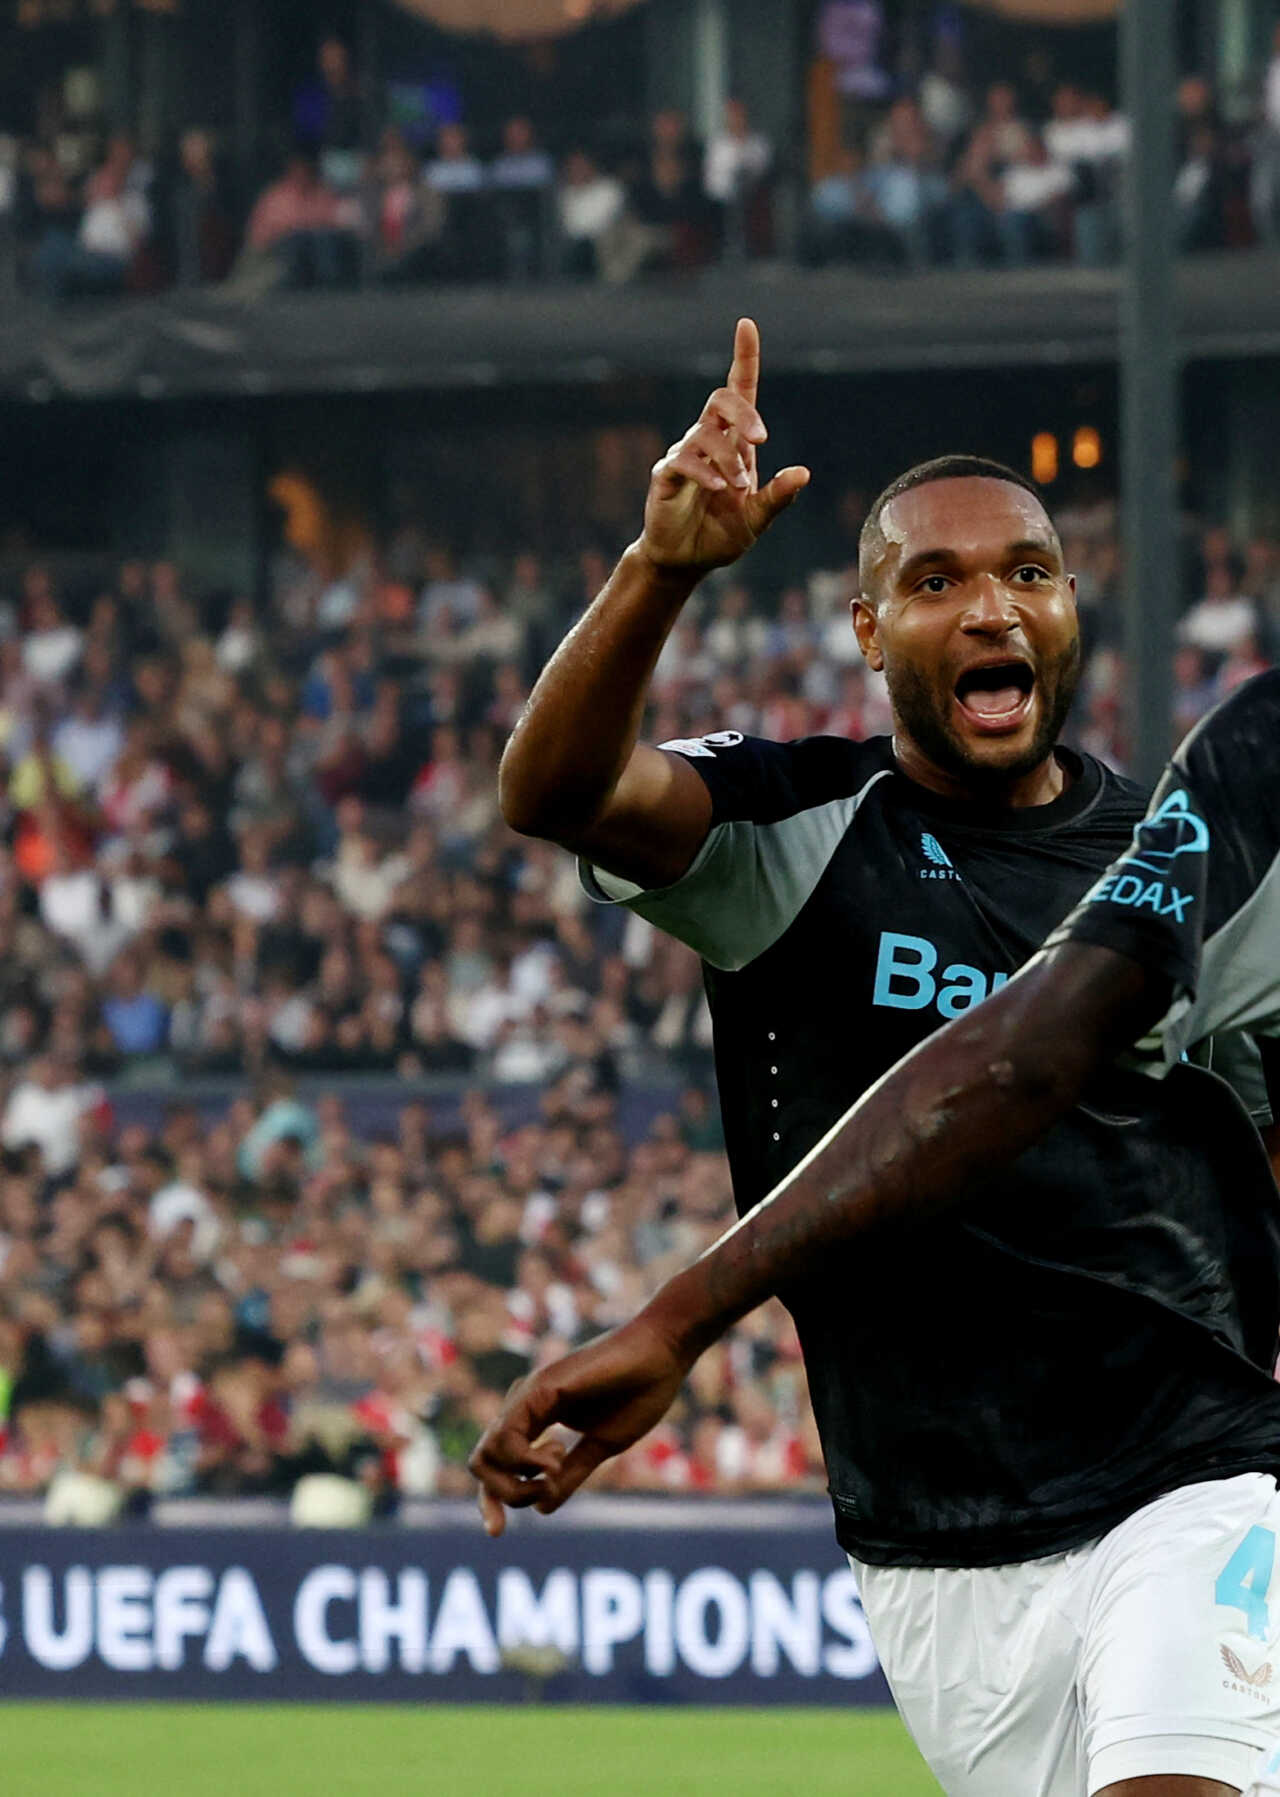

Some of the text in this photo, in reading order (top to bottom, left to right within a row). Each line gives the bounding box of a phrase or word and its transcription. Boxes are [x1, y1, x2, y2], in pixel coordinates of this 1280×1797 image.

[22, 1564, 279, 1673] UEFA
[293, 1563, 876, 1679] CHAMPIONS
[1215, 1524, 1276, 1642] 4
